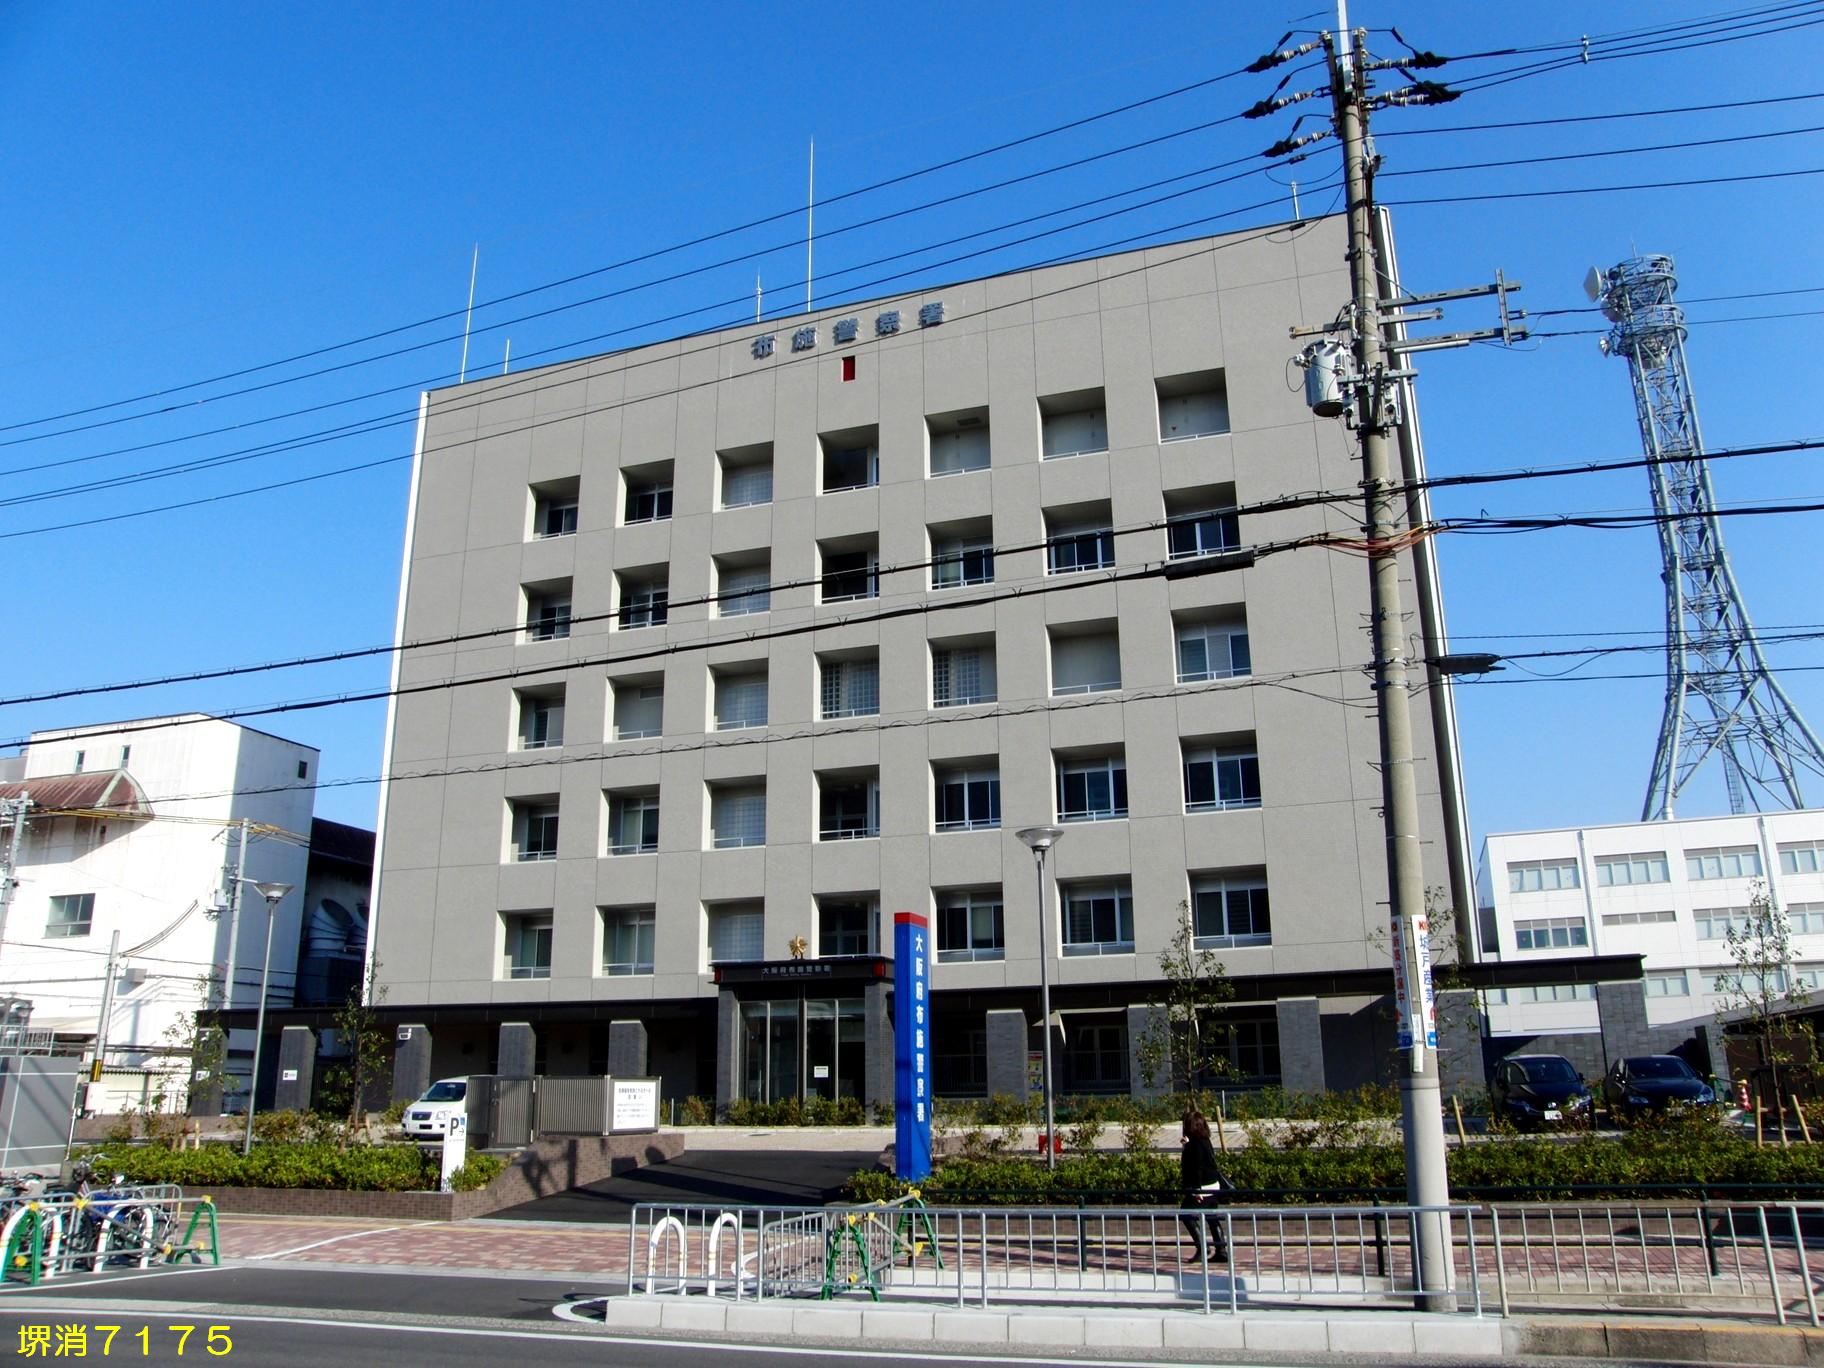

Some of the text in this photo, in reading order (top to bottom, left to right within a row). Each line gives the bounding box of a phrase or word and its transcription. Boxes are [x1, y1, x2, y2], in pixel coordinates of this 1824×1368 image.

[752, 302, 944, 359] 布施警察署
[915, 933, 924, 1122] 大阪府布施警察署
[450, 1117, 459, 1136] P
